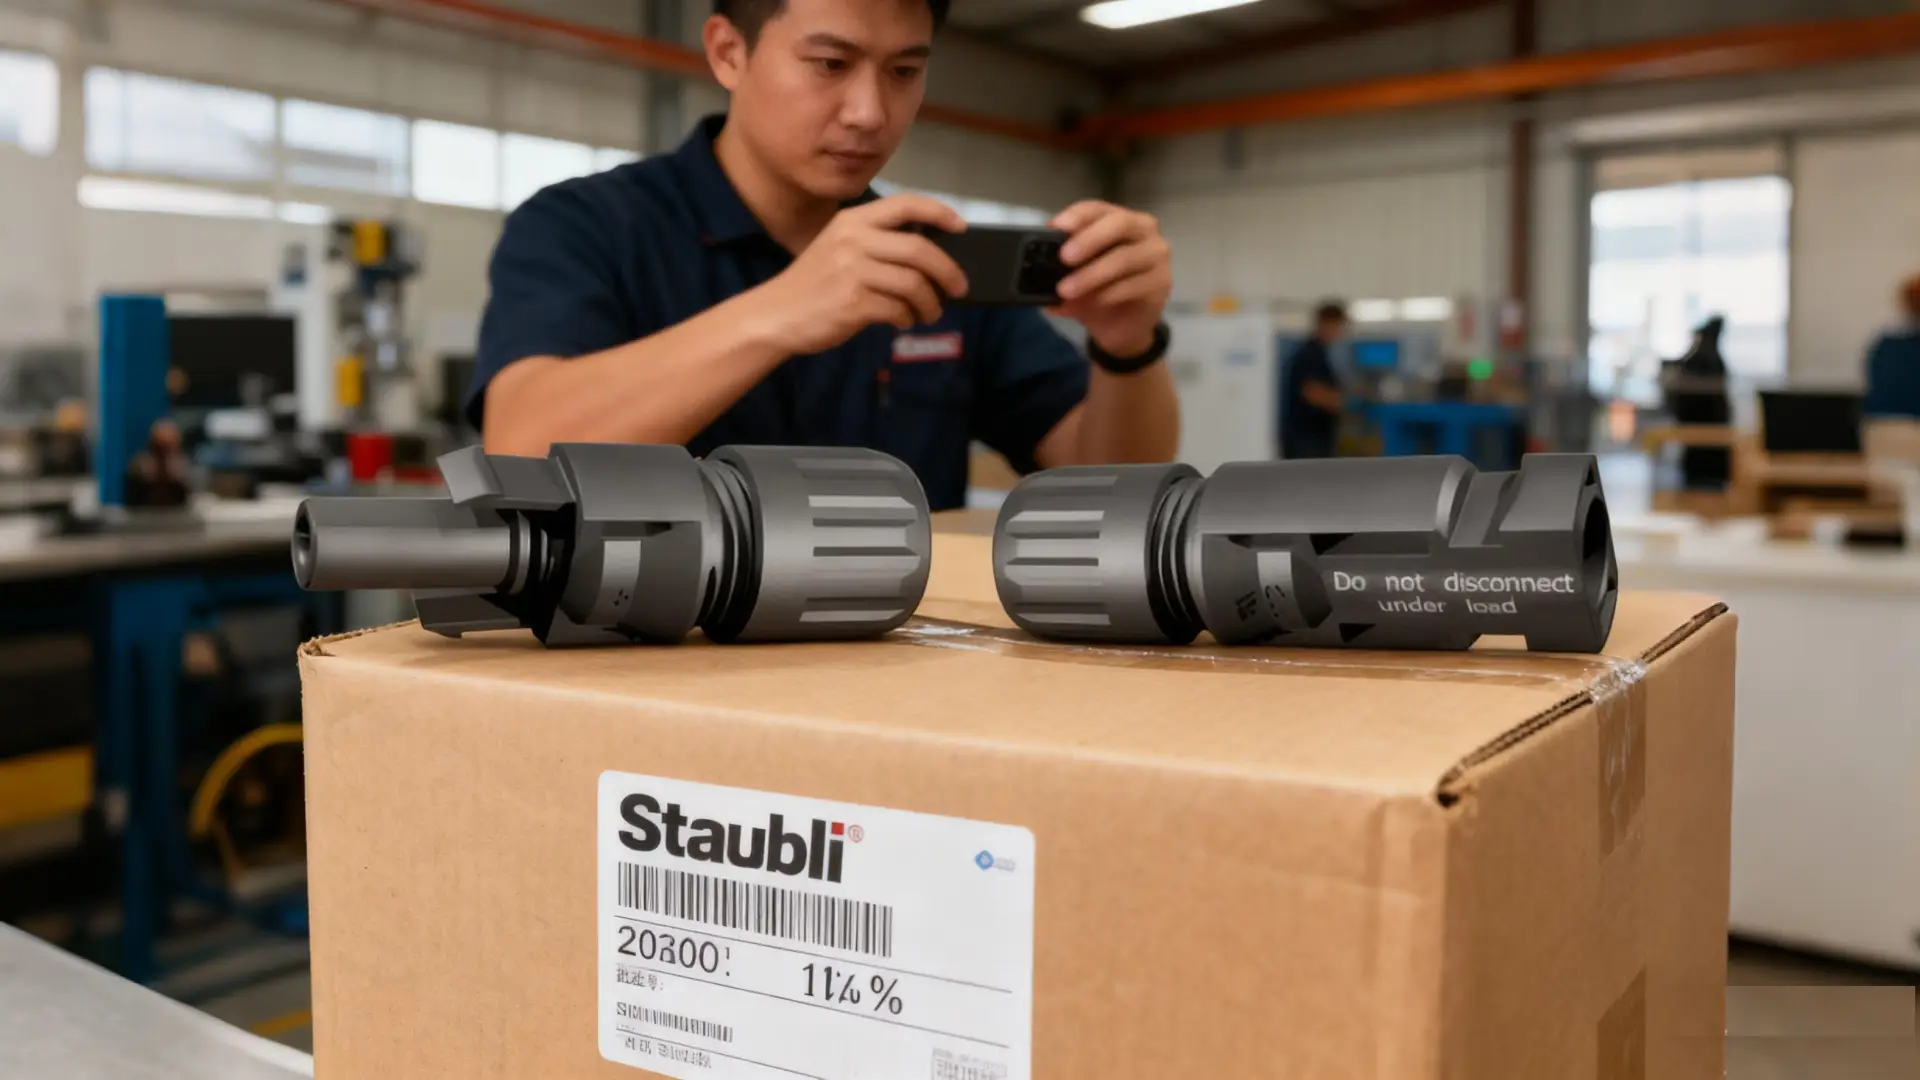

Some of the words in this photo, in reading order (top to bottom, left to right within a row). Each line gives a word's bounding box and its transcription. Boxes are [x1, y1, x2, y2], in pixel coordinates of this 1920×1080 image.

[1333, 571, 1366, 591] Do
[1385, 573, 1425, 592] not
[1444, 572, 1575, 593] disconnect
[1377, 596, 1446, 613] under
[1466, 597, 1518, 614] load
